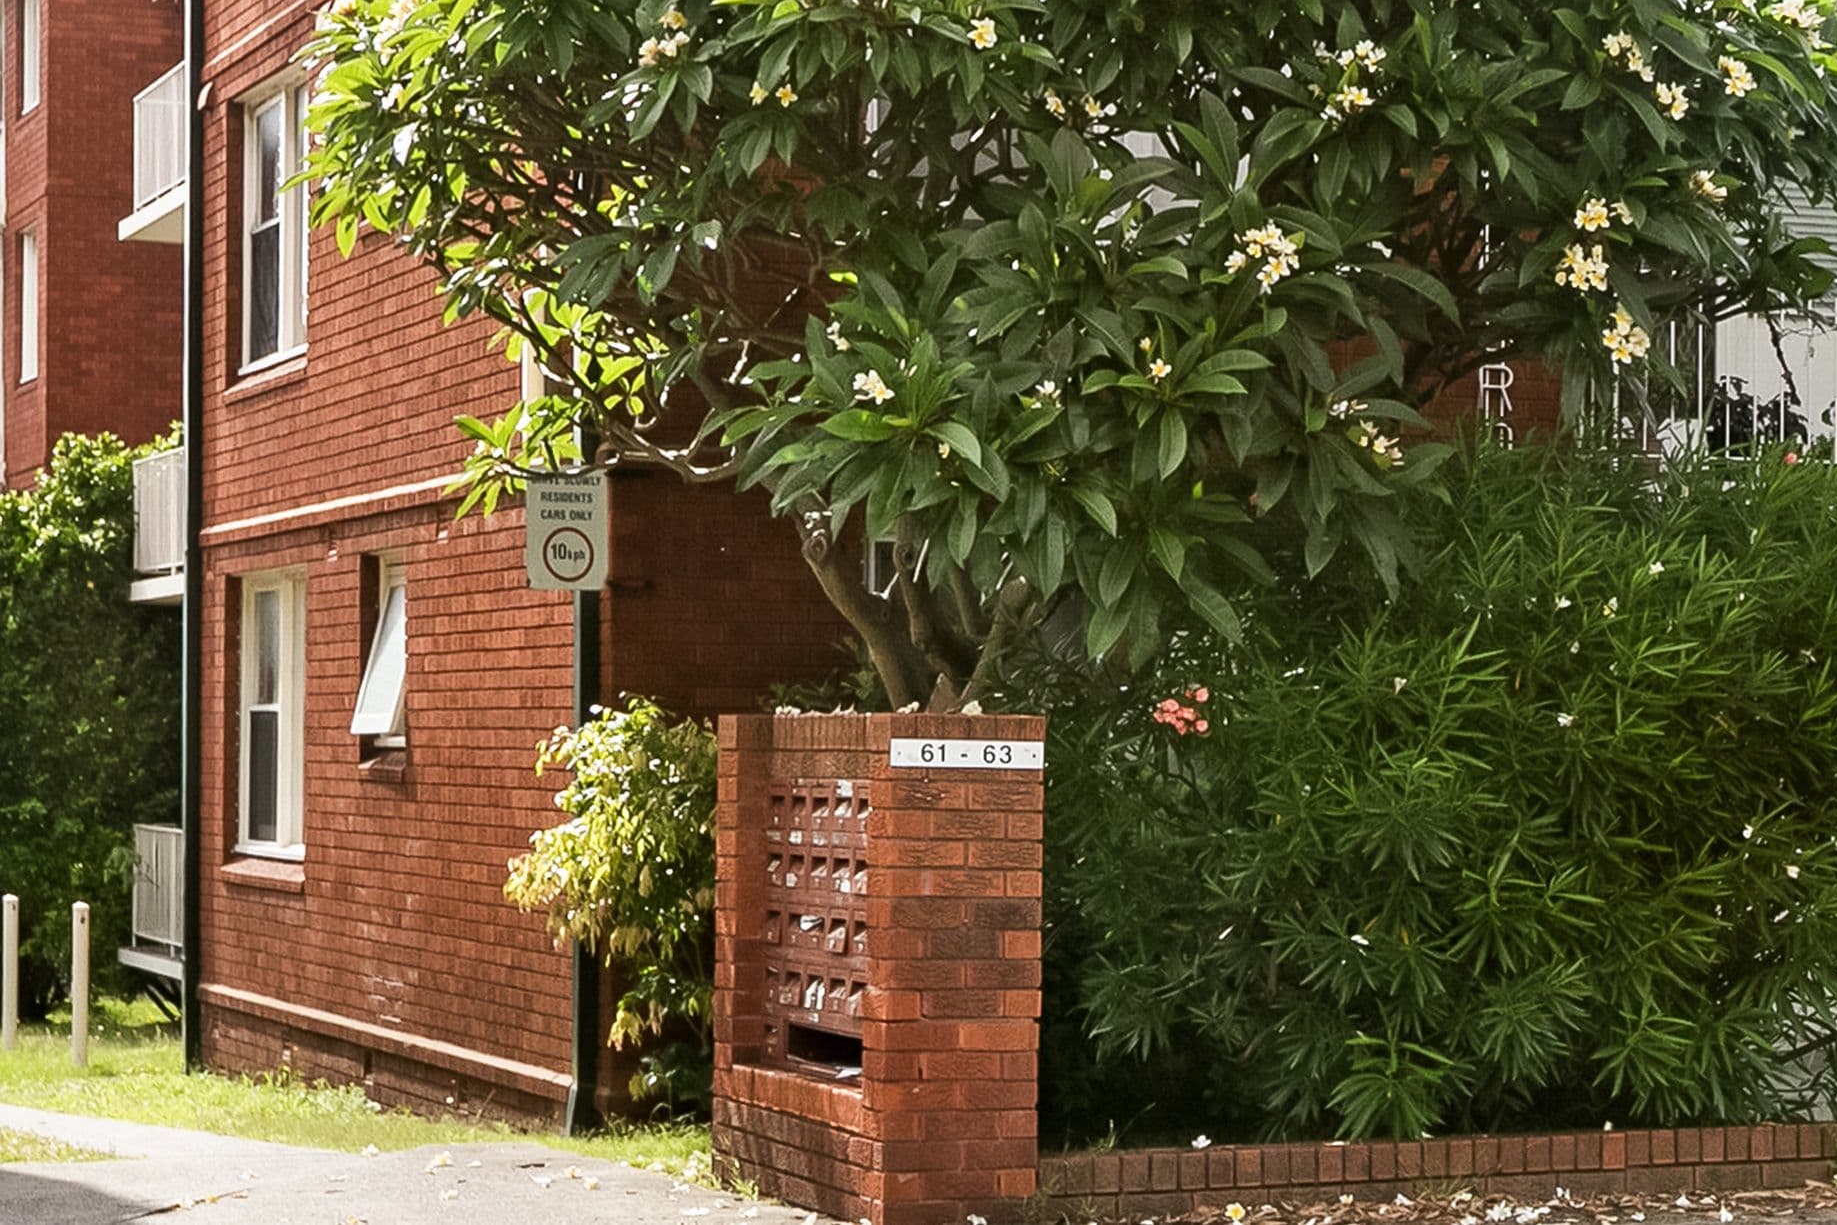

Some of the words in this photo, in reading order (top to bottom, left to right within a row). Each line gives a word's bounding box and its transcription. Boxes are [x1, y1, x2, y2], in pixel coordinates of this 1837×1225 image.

[540, 491, 593, 503] RESIDENTS
[540, 509, 566, 521] CARS
[569, 510, 593, 521] ONLY
[921, 743, 946, 762] 61
[983, 745, 1012, 764] 63
